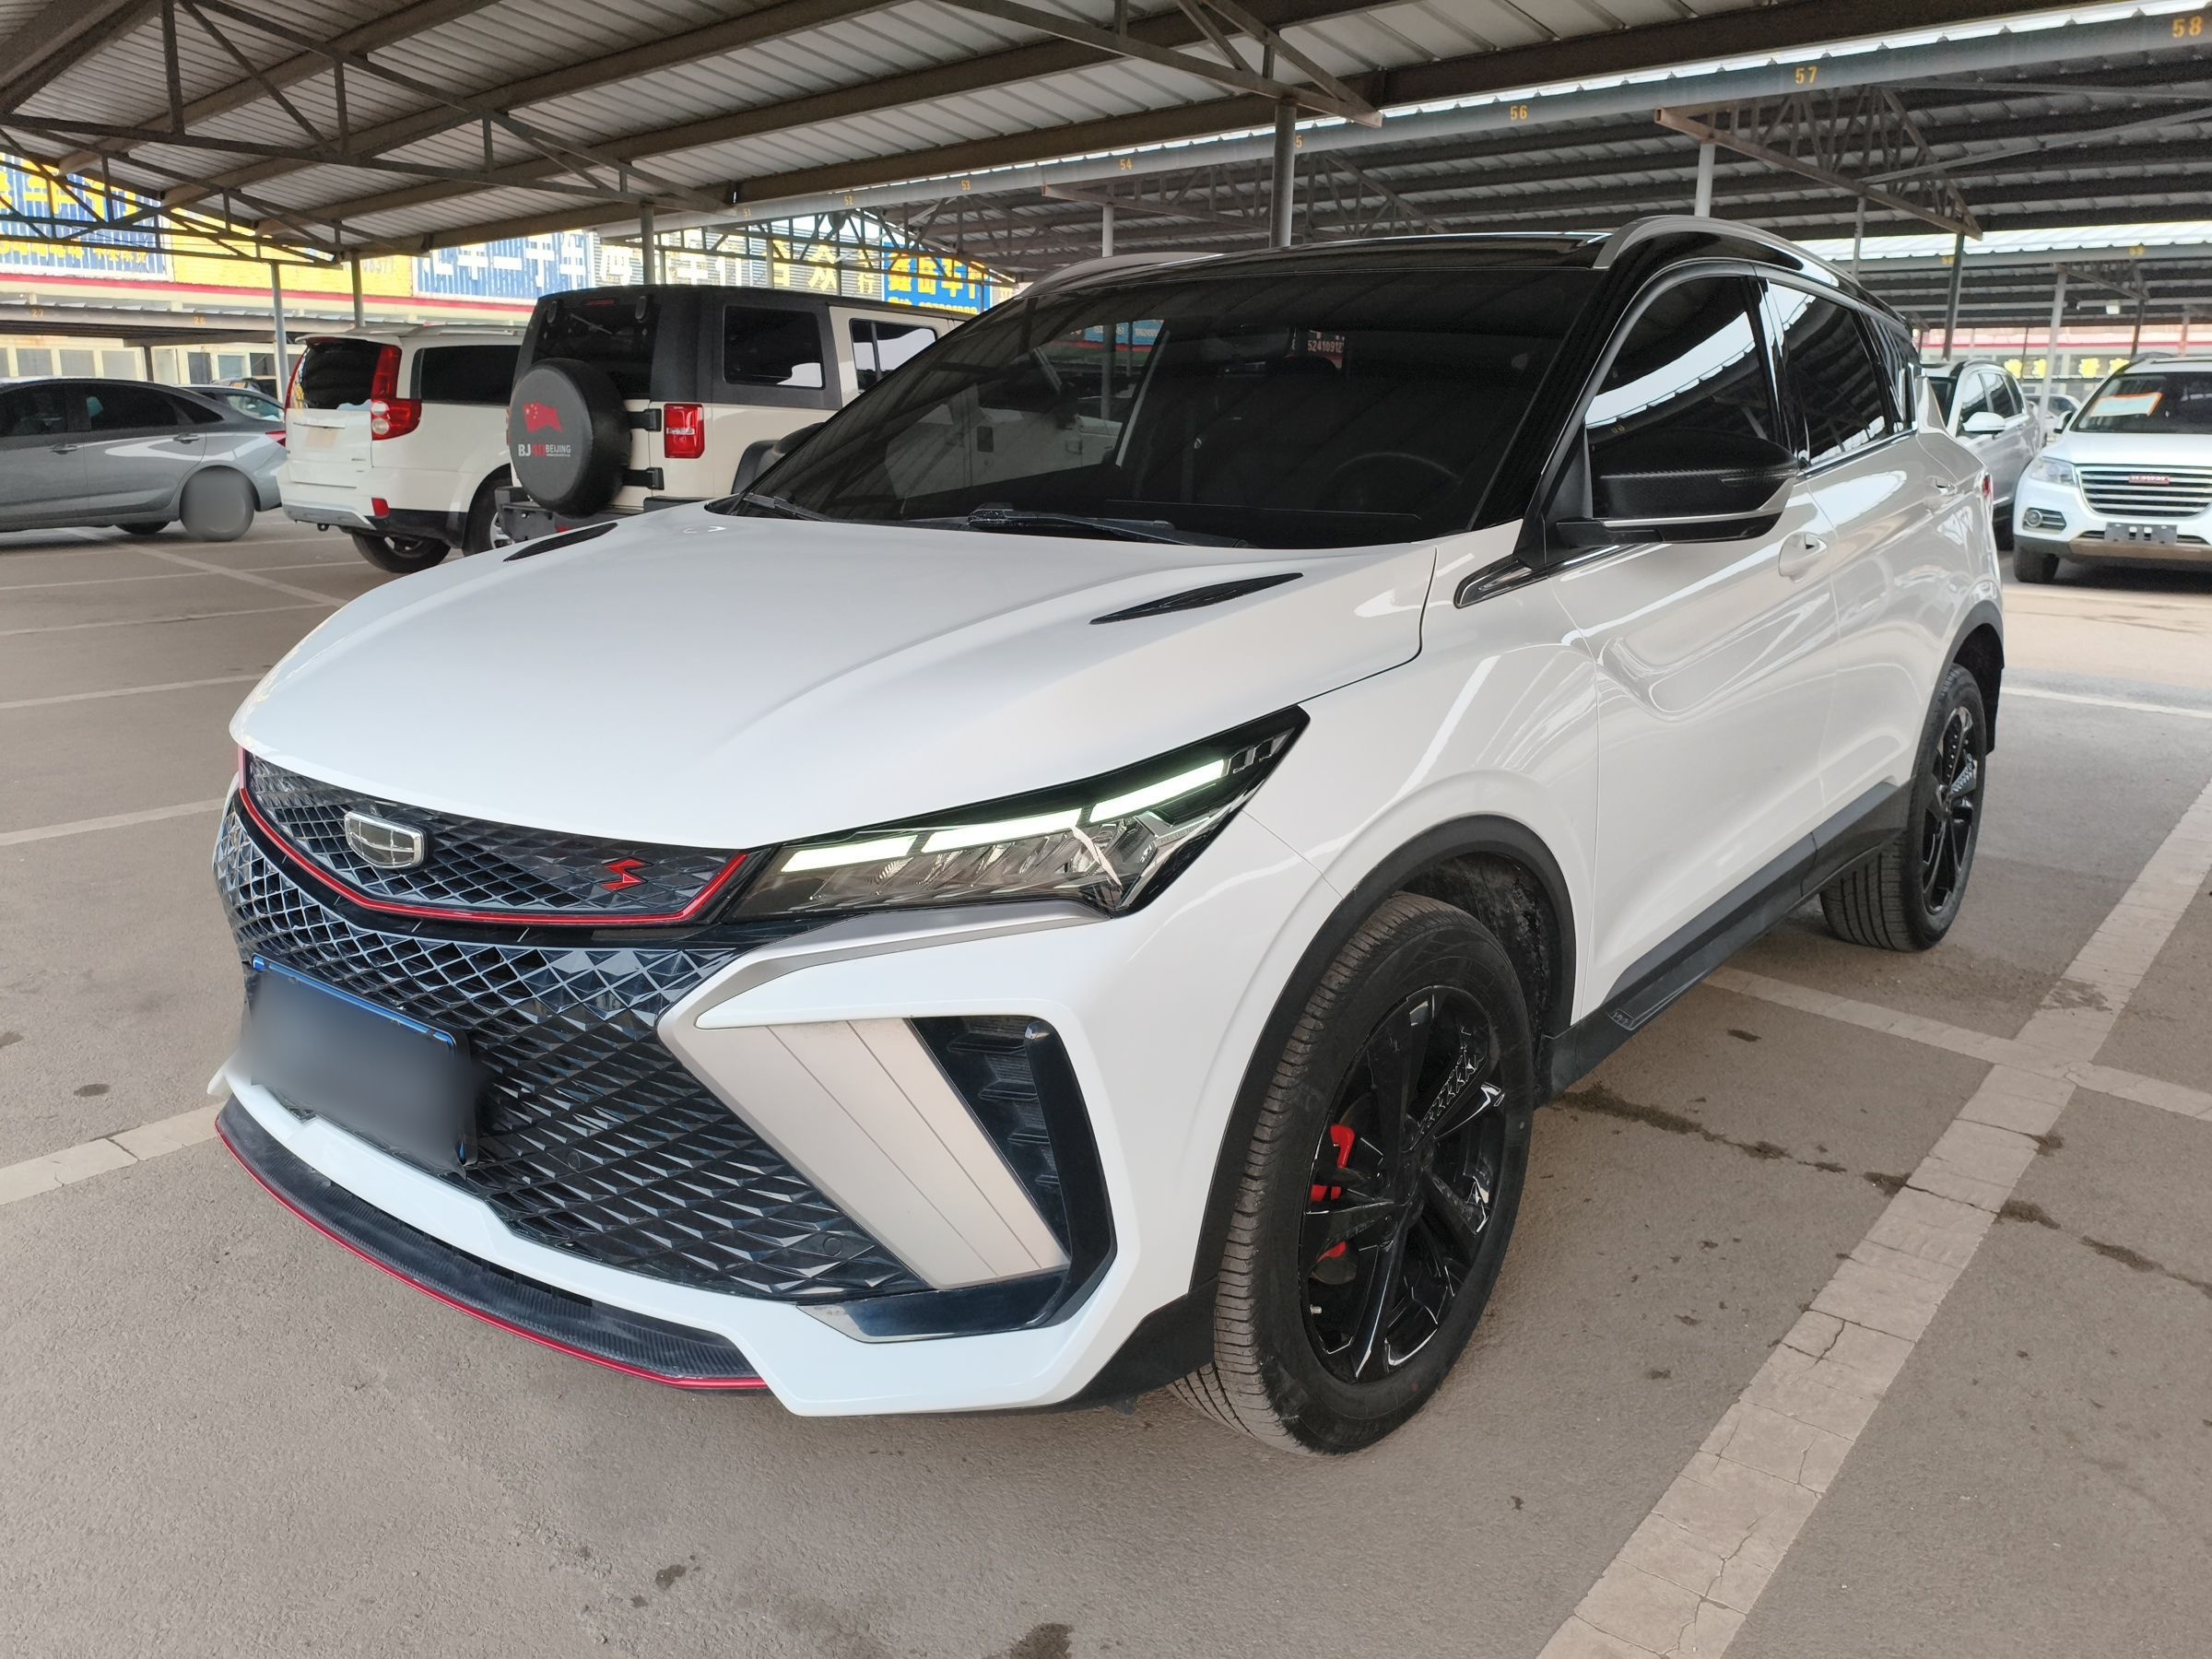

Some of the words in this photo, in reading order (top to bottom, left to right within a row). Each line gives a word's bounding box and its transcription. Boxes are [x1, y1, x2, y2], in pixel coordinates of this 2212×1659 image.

[2172, 16, 2203, 38] 58
[1795, 66, 1818, 85] 57
[1510, 105, 1528, 120] 56
[1120, 159, 1133, 170] 54
[960, 180, 971, 191] 53
[843, 194, 854, 206] 52
[546, 444, 571, 453] BEIJING
